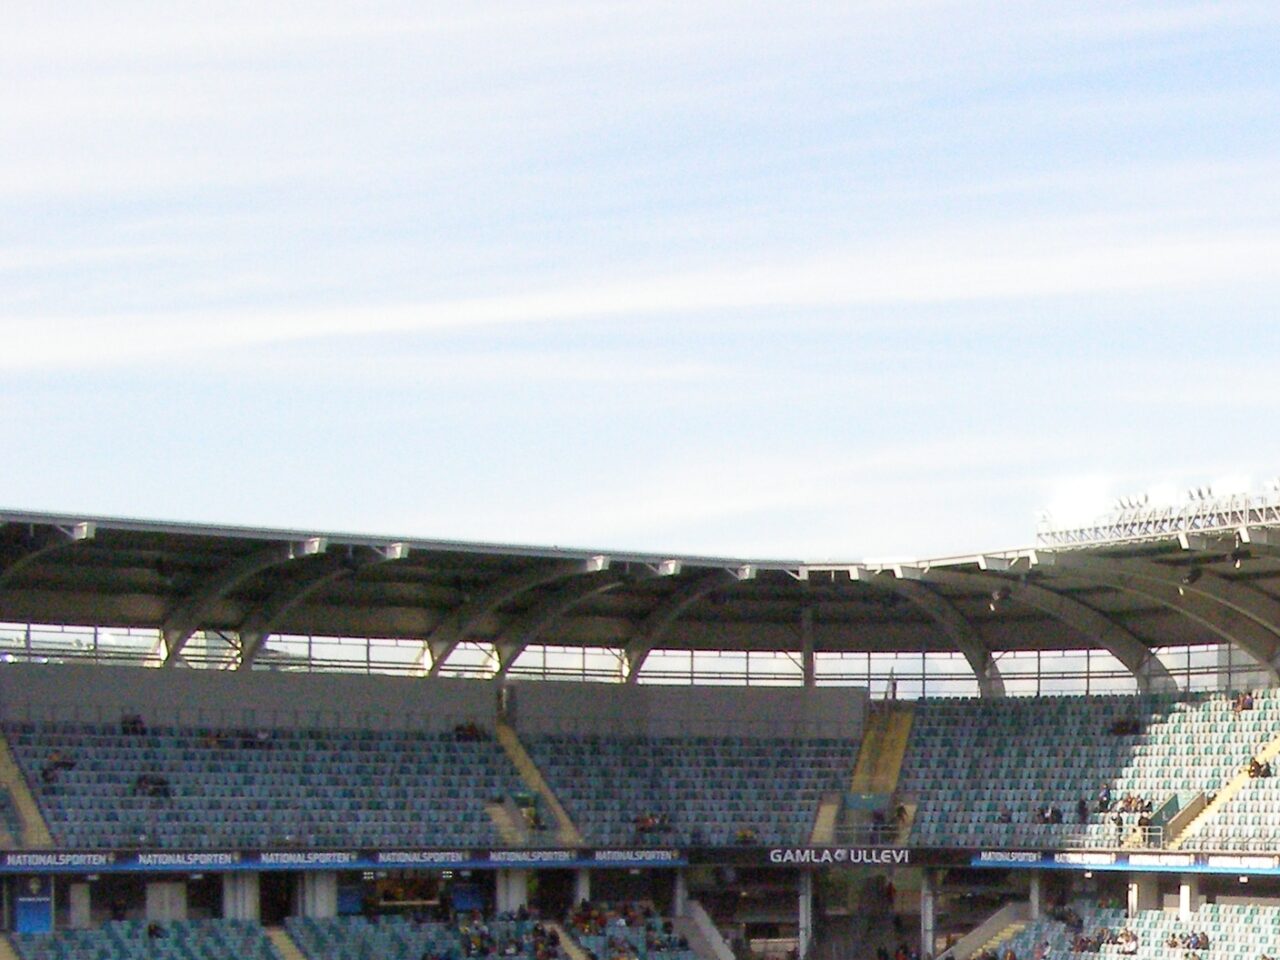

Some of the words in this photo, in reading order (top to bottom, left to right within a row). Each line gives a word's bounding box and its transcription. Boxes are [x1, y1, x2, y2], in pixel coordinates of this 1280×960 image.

[7, 854, 107, 865] NATIONALSPORTEN
[138, 853, 232, 864] NATIONALSPORTEN
[261, 852, 350, 863] NATIONALSPORTEN
[378, 852, 462, 862] NATIONALSPORTEN
[489, 851, 570, 861] NATIONALSPORTEN
[770, 849, 833, 863] GAMLA
[850, 849, 909, 863] ULLEVI
